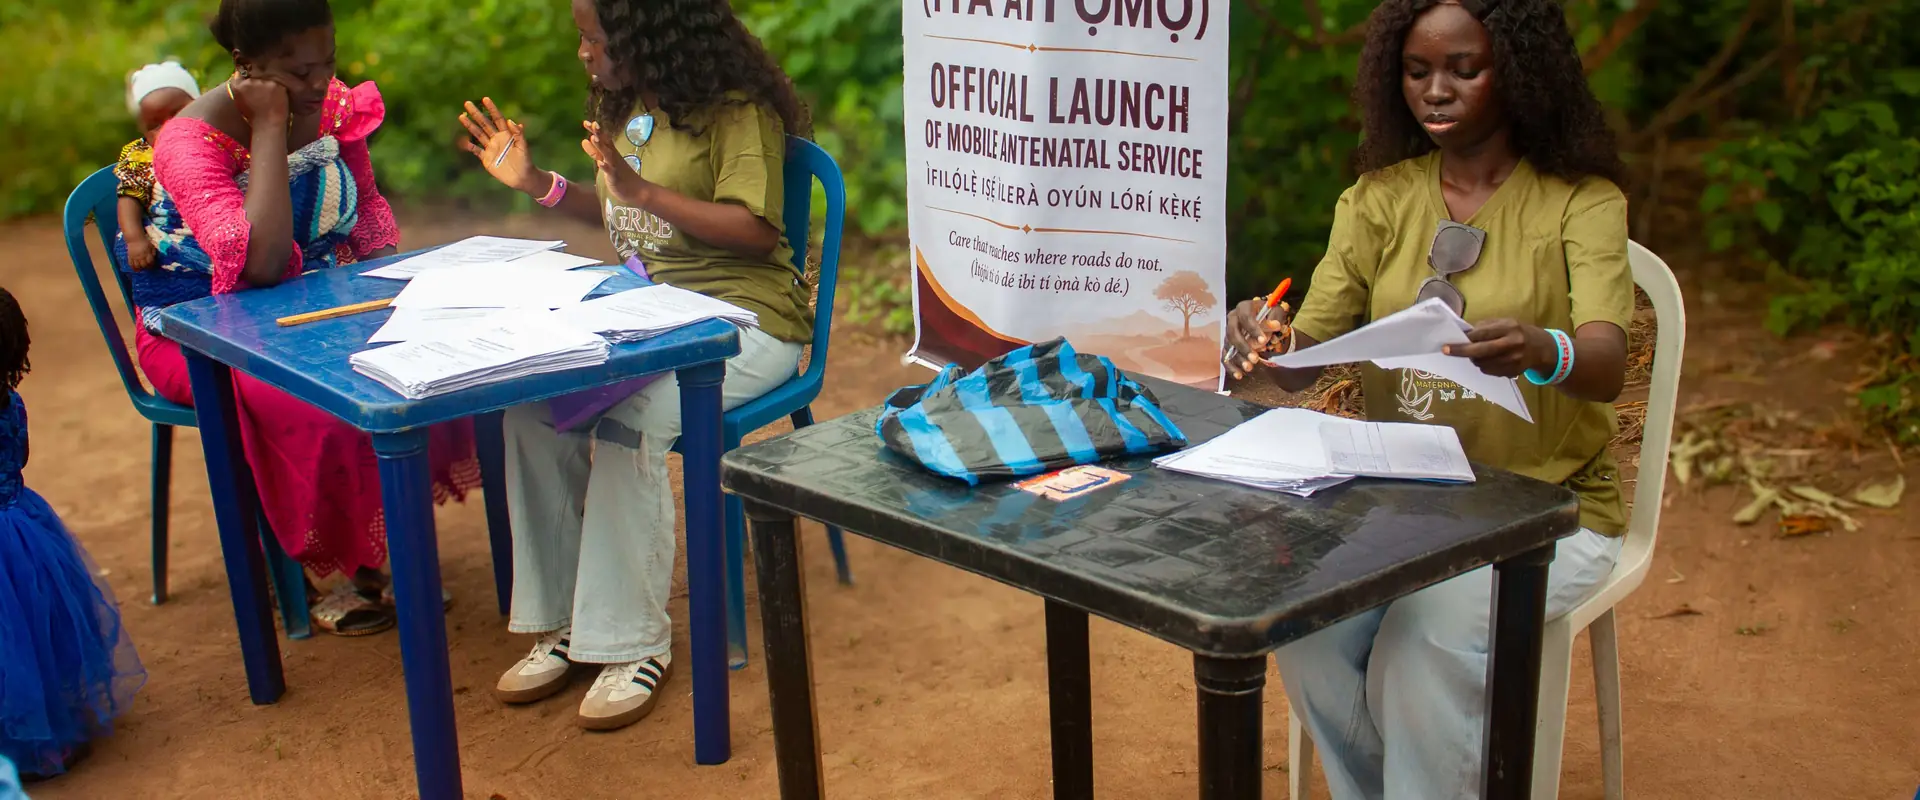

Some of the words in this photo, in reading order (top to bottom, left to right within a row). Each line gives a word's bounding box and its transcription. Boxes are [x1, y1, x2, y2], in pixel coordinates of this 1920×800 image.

[930, 62, 1034, 122] OFFICIAL
[1049, 77, 1189, 133] LAUNCH
[925, 119, 941, 149] OF
[947, 122, 998, 159] MOBILE
[1000, 132, 1110, 169] ANTENATAL
[1118, 141, 1202, 179] SERVICE
[1047, 185, 1101, 208] OYÚN
[1111, 188, 1152, 212] LÓRÍ
[949, 231, 971, 248] Care
[973, 235, 988, 253] that
[989, 245, 1020, 263] reaches
[1024, 248, 1067, 265] where
[1072, 251, 1111, 267] roads
[1115, 252, 1132, 268] do
[1138, 259, 1162, 272] not.
[1001, 272, 1014, 288] dé
[1018, 273, 1035, 289] ibi
[1040, 275, 1050, 290] tí
[1054, 275, 1079, 293] ọ̀nà
[1084, 276, 1100, 292] kò
[1104, 277, 1129, 297] dé.)
